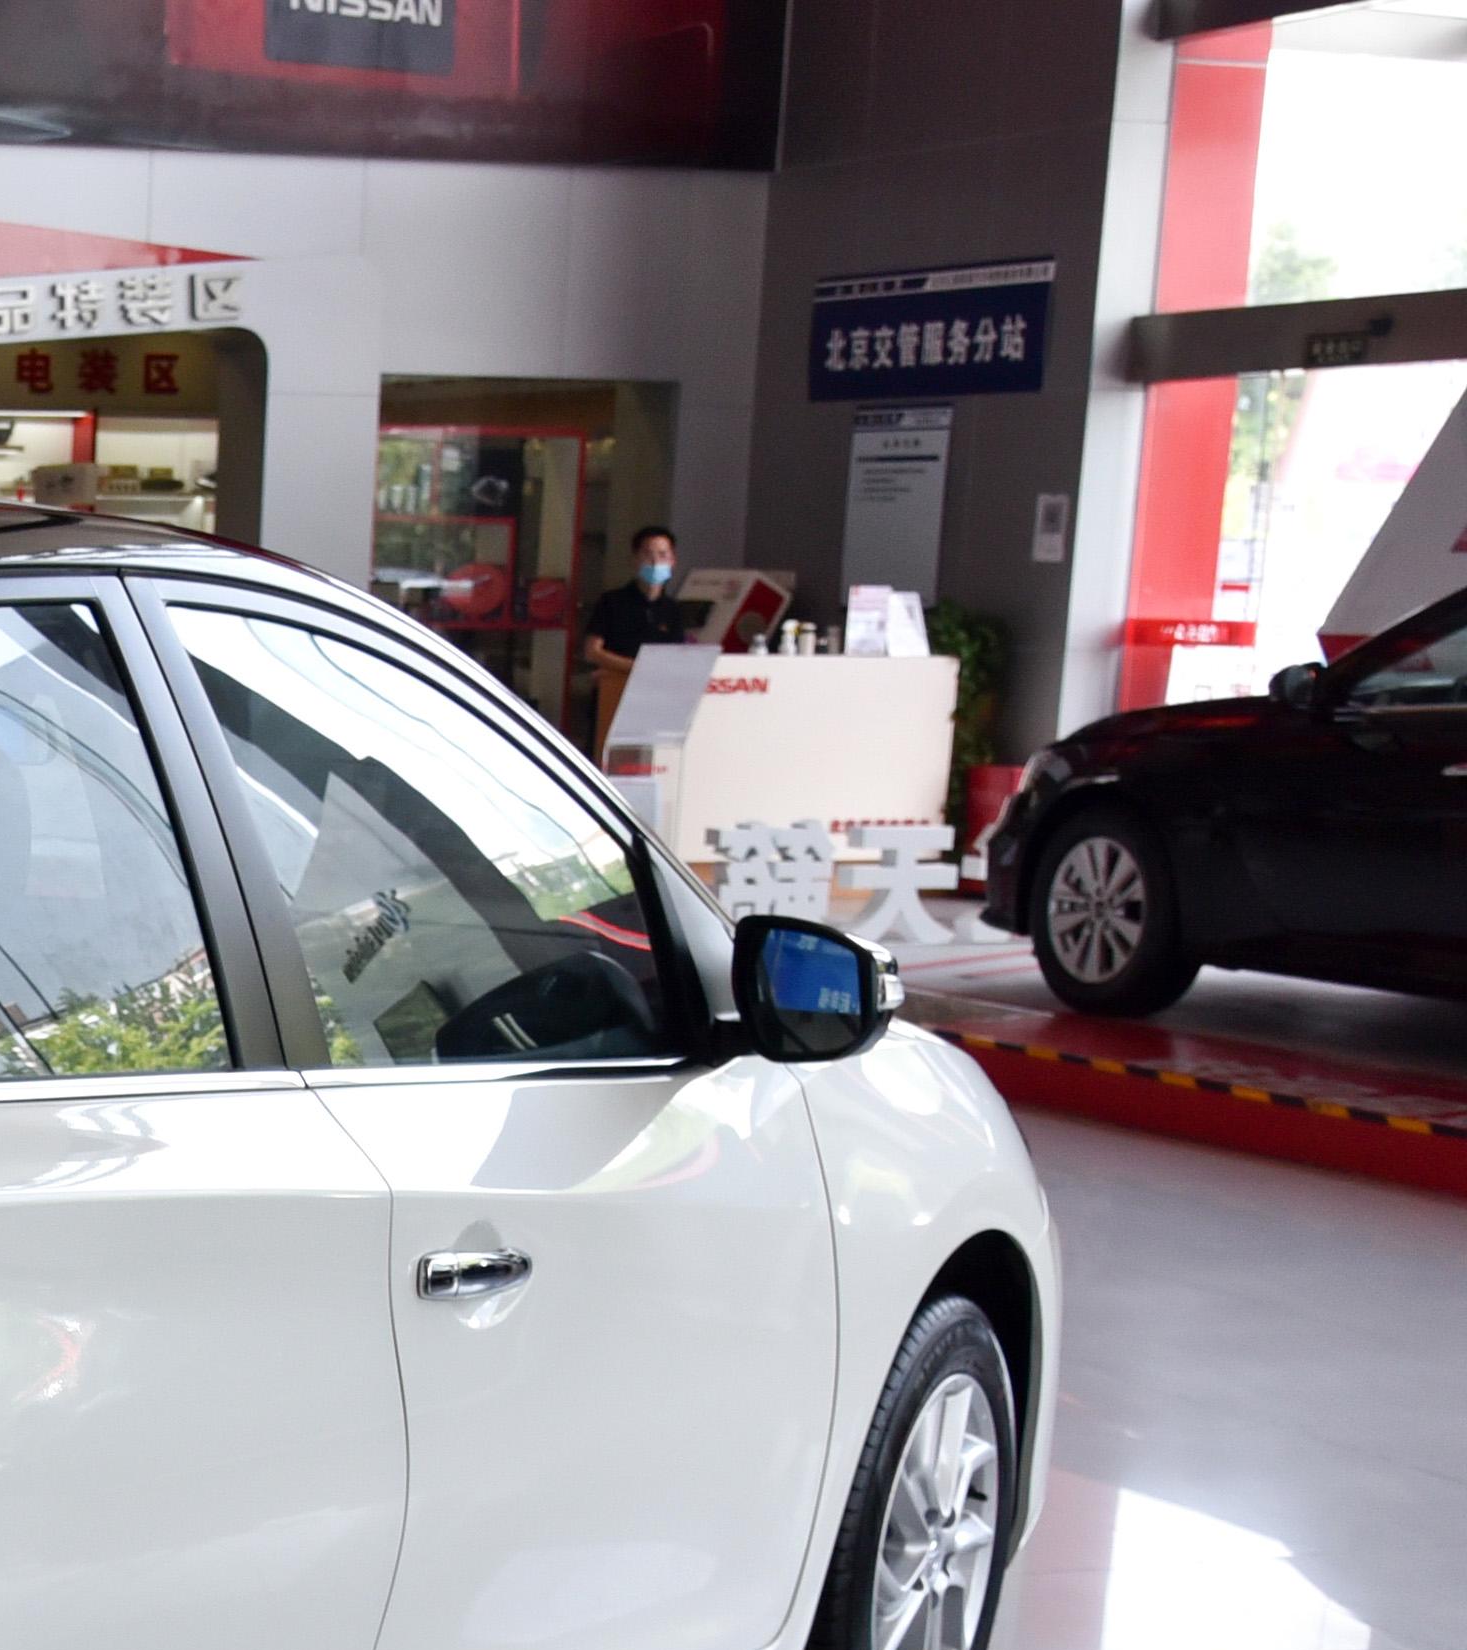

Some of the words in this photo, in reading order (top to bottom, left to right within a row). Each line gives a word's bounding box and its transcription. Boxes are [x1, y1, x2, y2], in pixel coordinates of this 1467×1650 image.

[824, 313, 1028, 362] 北京交管服务分站
[17, 348, 179, 394] 电装区
